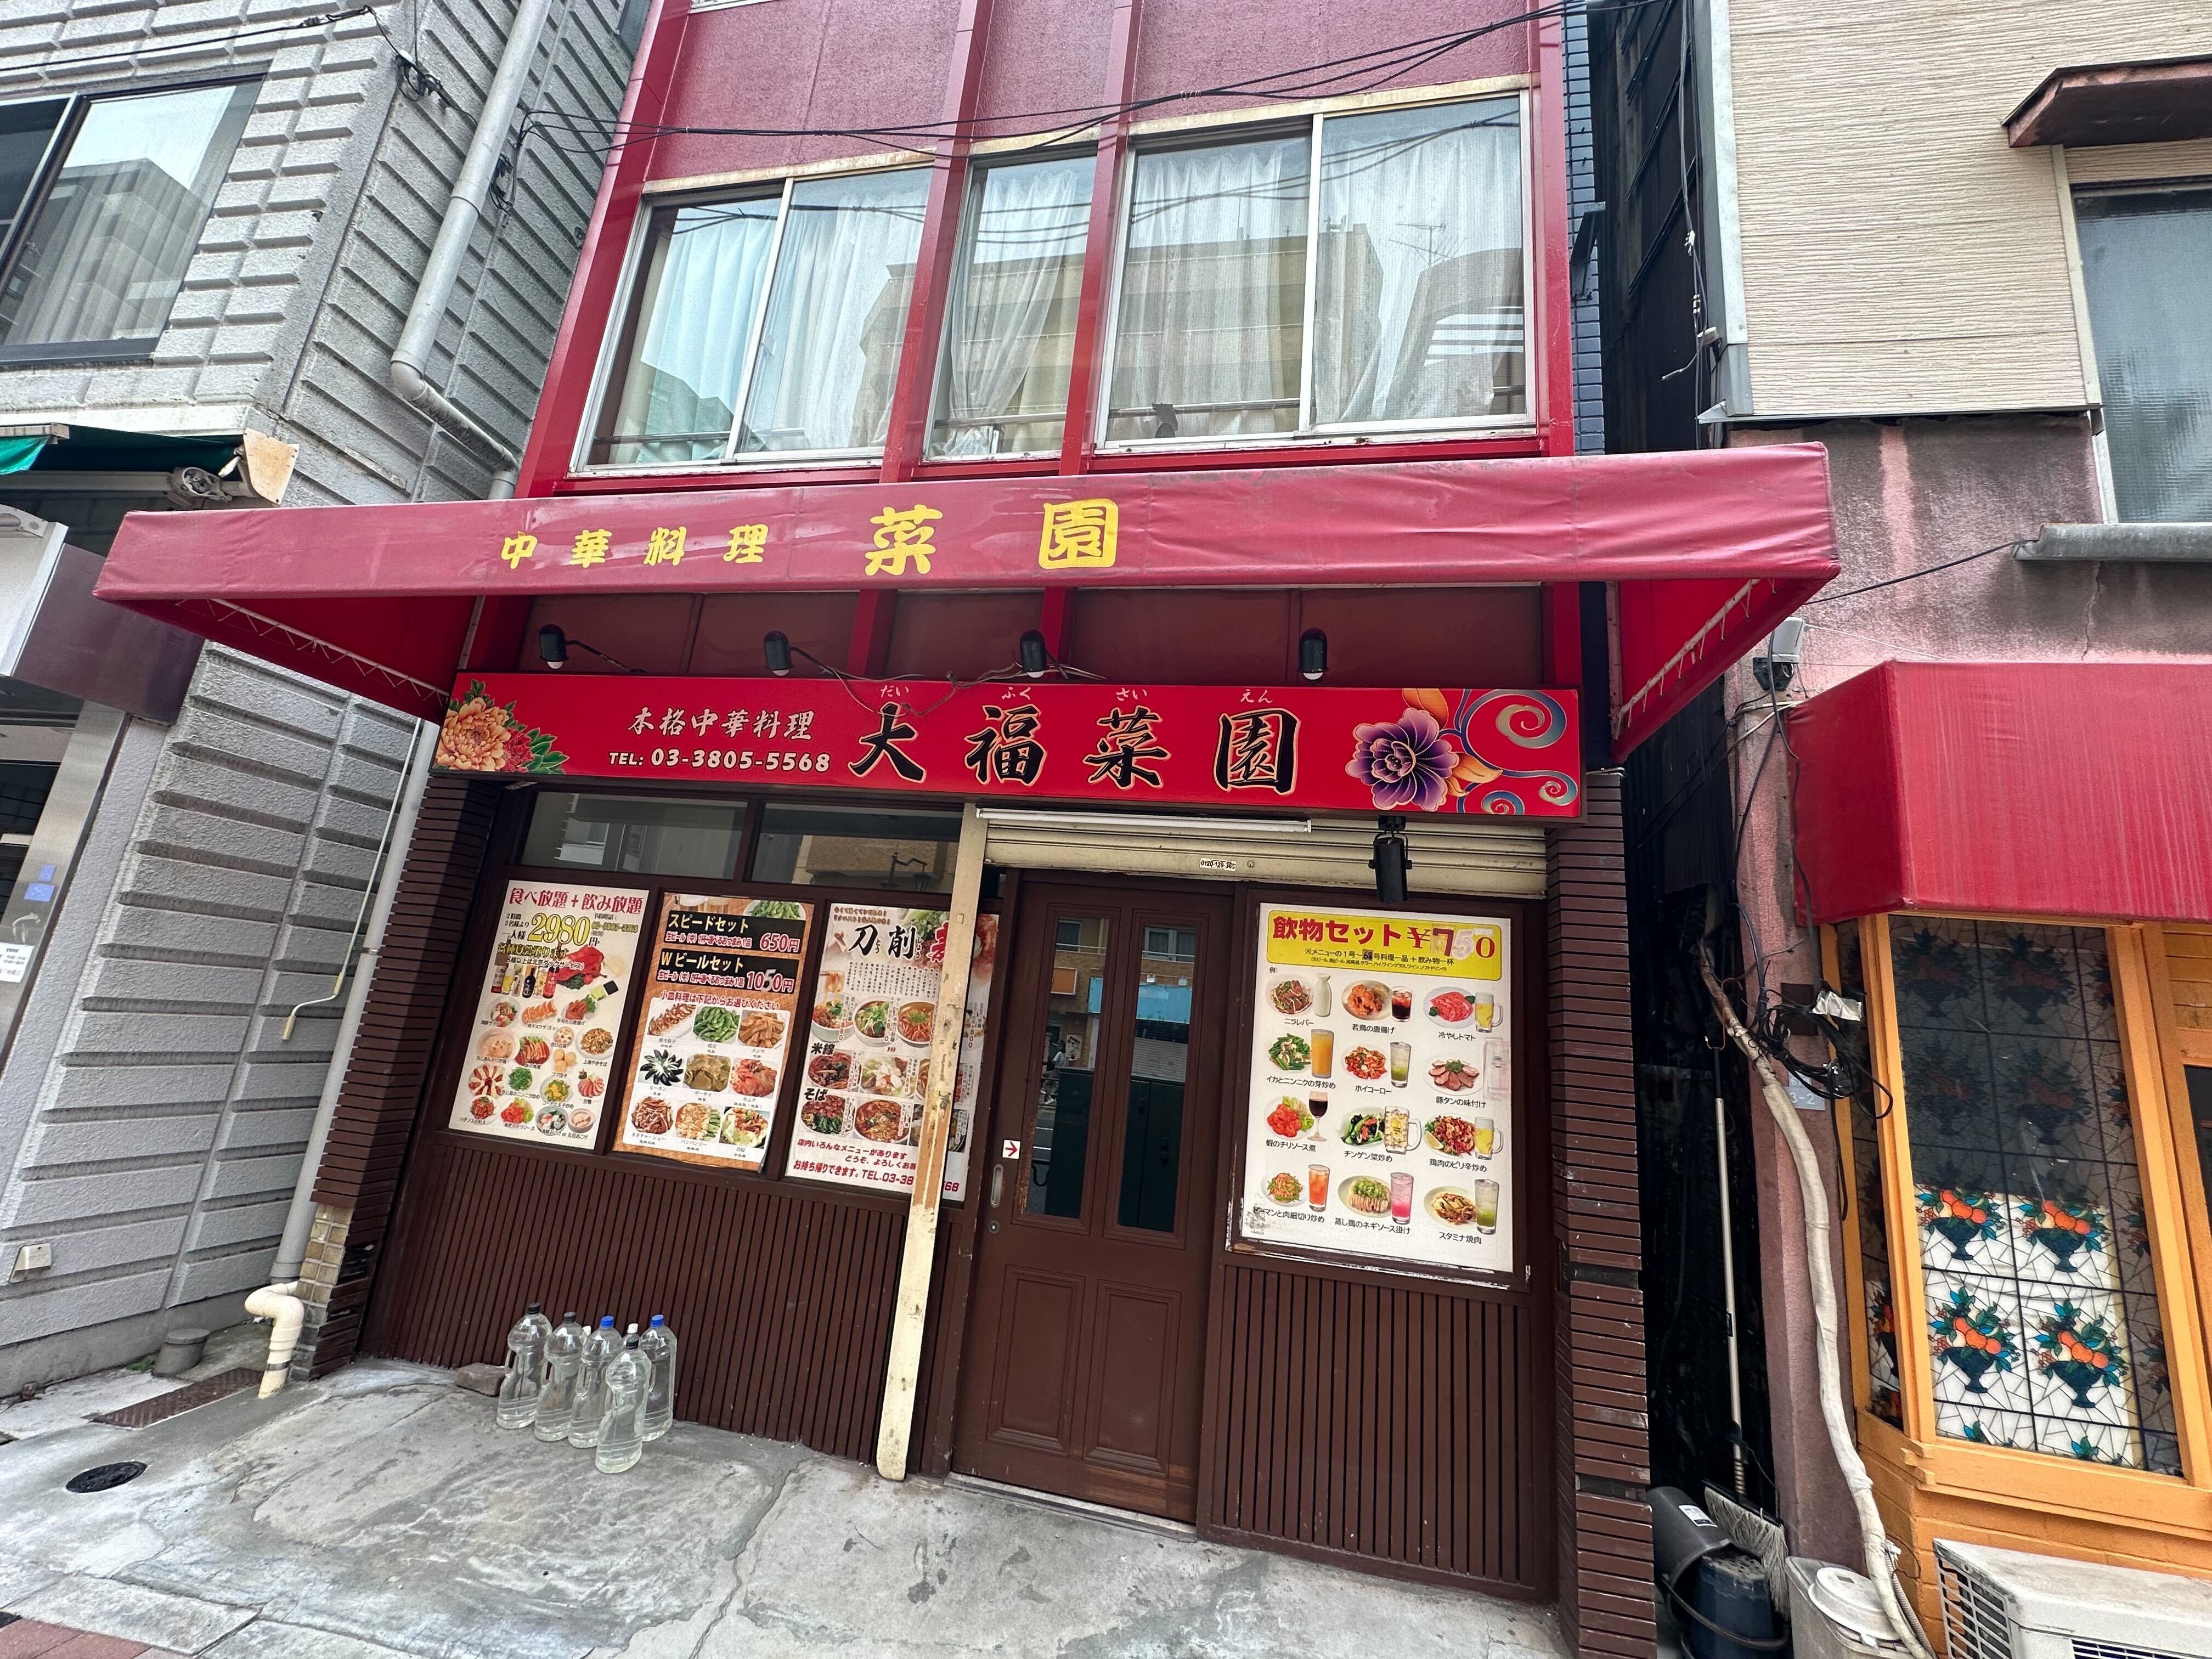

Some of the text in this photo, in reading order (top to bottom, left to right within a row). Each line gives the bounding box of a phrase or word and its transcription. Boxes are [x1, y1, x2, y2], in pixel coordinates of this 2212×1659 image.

[501, 498, 1119, 576] 中華料理 菜園
[880, 685, 1273, 703] だい ふく さい えん
[628, 706, 816, 740] 本格中華料理
[848, 701, 1302, 795] 大福菜園
[609, 748, 831, 772] TEL: 03-3805-5568
[527, 912, 591, 946] 2980
[668, 913, 749, 934] スピードセット
[1272, 915, 1402, 947] 飲物セット
[759, 932, 801, 953] 650円
[1284, 1018, 1314, 1026] ニラレバー
[1351, 1023, 1395, 1035] 若鶏の唐揚げ
[1438, 1030, 1476, 1042] 冷やしトマト
[810, 1042, 834, 1056] 米線
[1266, 1075, 1336, 1090] イカとニンニクの芽炒め
[1355, 1085, 1392, 1095] ホイコーロー
[803, 1087, 828, 1102] そば
[1790, 1092, 1815, 1105] 3-2
[1435, 1096, 1486, 1109] 豚タンの味付け
[797, 1138, 908, 1160] 店内いろんなメニューがあります
[1344, 1150, 1393, 1163] チンゲン菜炒め
[1429, 1158, 1487, 1172] 鶏肉のピリ辛炒め
[1438, 1232, 1482, 1245] スタミナ焼肉
